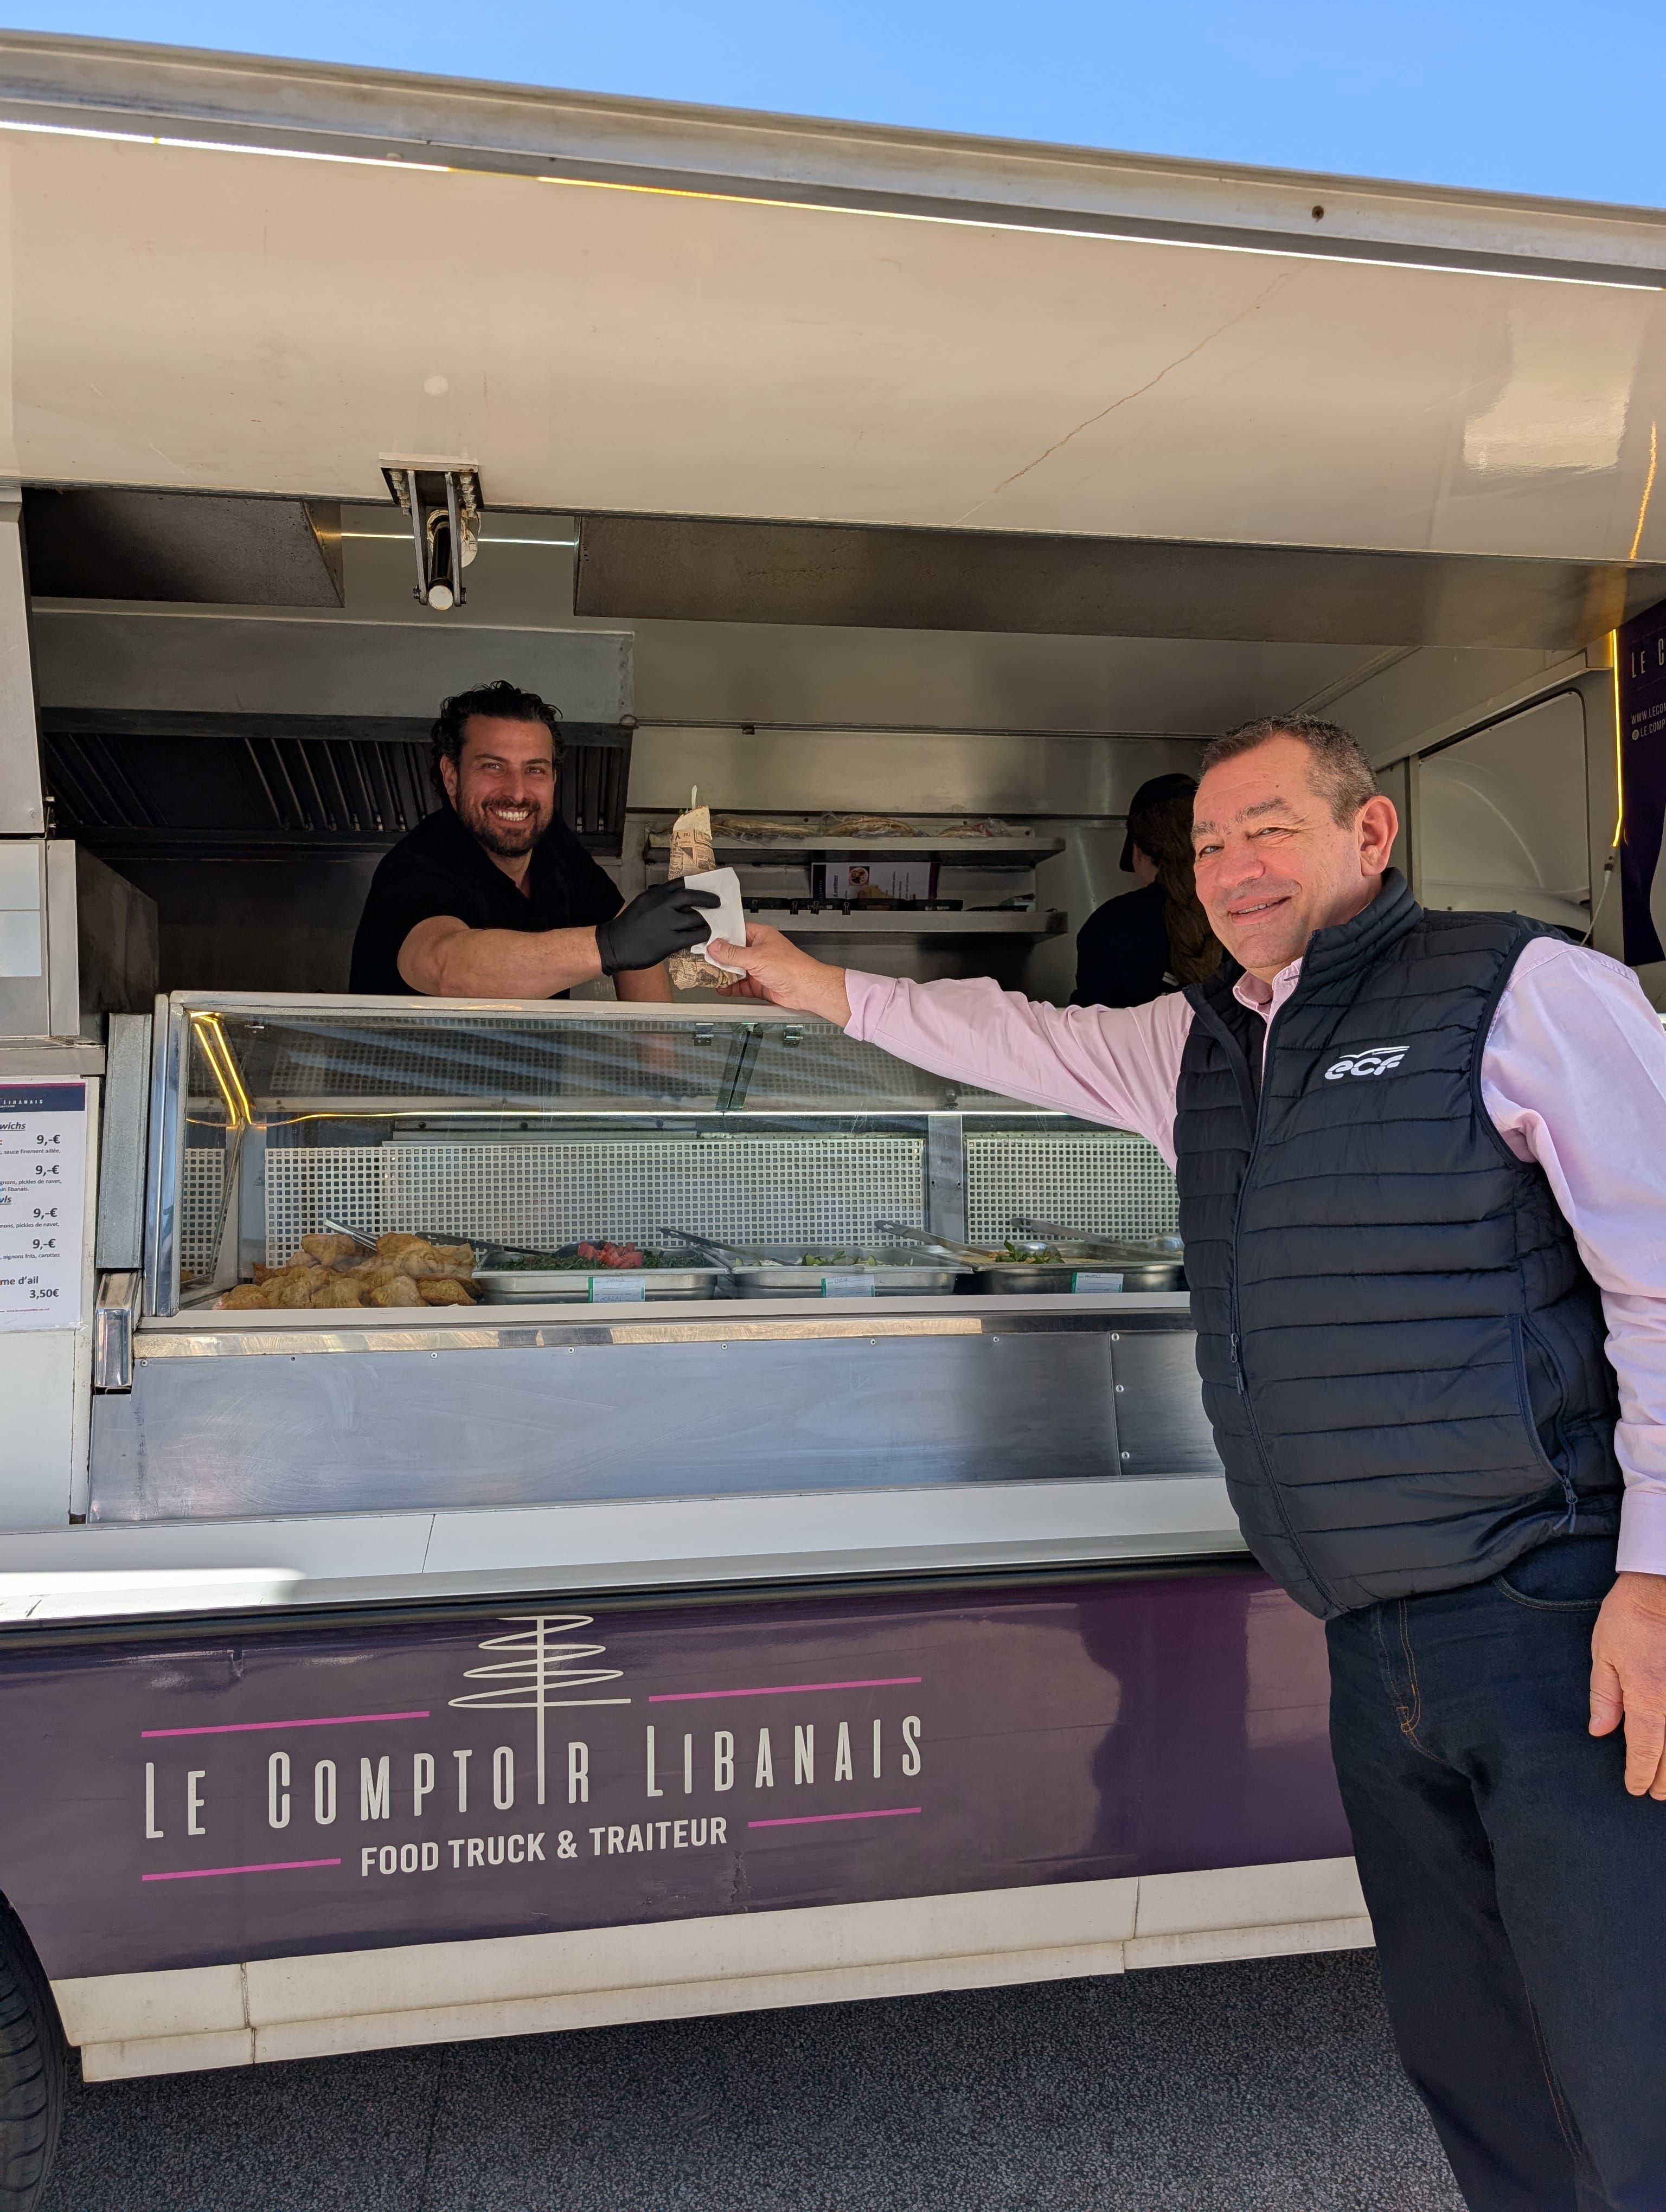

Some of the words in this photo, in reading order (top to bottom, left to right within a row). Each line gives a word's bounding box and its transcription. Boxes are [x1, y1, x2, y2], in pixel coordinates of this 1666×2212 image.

[1631, 651, 1646, 678] LE
[29, 1288, 60, 1300] 3,50€
[146, 1762, 206, 1839] LE
[268, 1741, 589, 1829] COMPTOIR
[647, 1715, 921, 1798] LIBANAIS
[361, 1841, 439, 1877] FOOD
[448, 1832, 546, 1869] TRUCK
[557, 1829, 578, 1860] &
[589, 1816, 727, 1856] TRAITEUR
